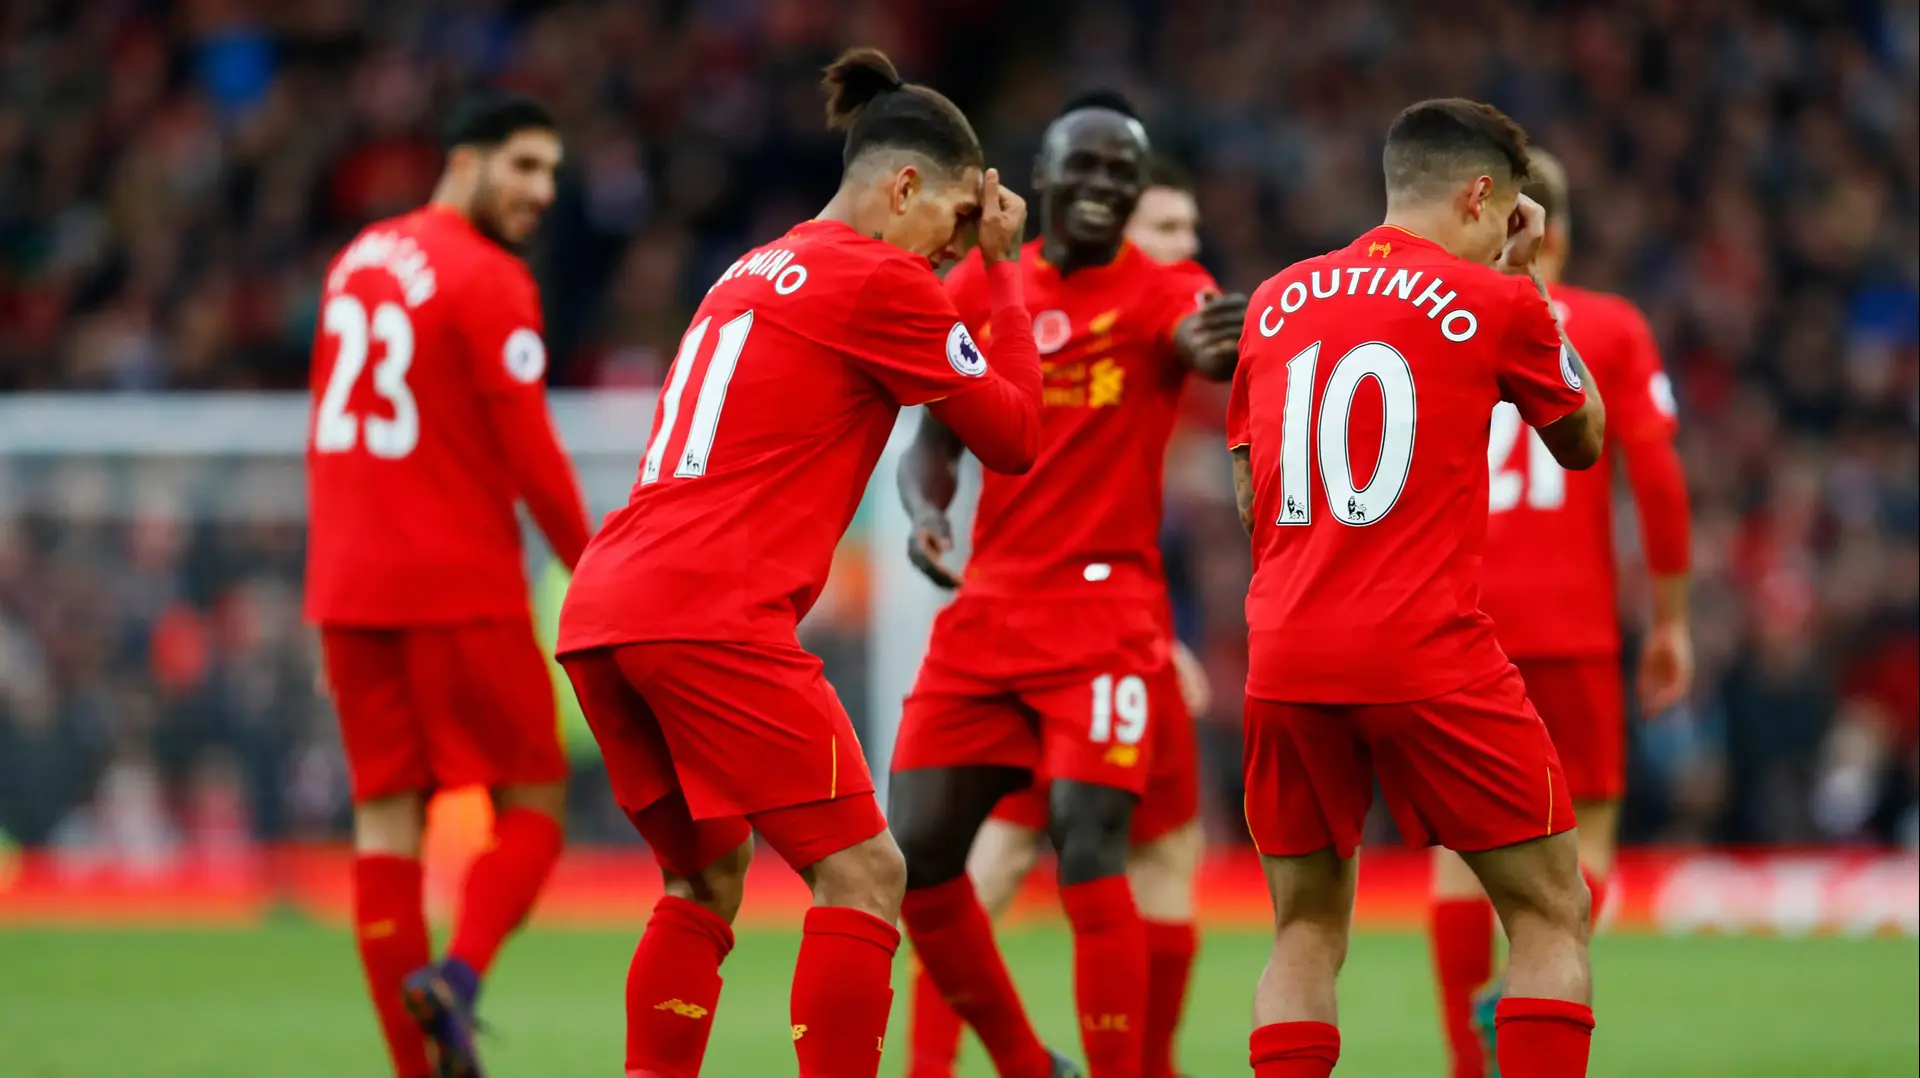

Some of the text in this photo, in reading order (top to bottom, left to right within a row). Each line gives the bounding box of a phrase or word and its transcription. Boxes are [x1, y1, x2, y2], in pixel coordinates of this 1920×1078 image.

[1259, 267, 1478, 342] COUTINHO
[315, 294, 419, 459] 23
[641, 309, 754, 487] 11
[1276, 340, 1417, 527] 10
[1486, 400, 1566, 514] 21
[1089, 673, 1148, 744] 19
